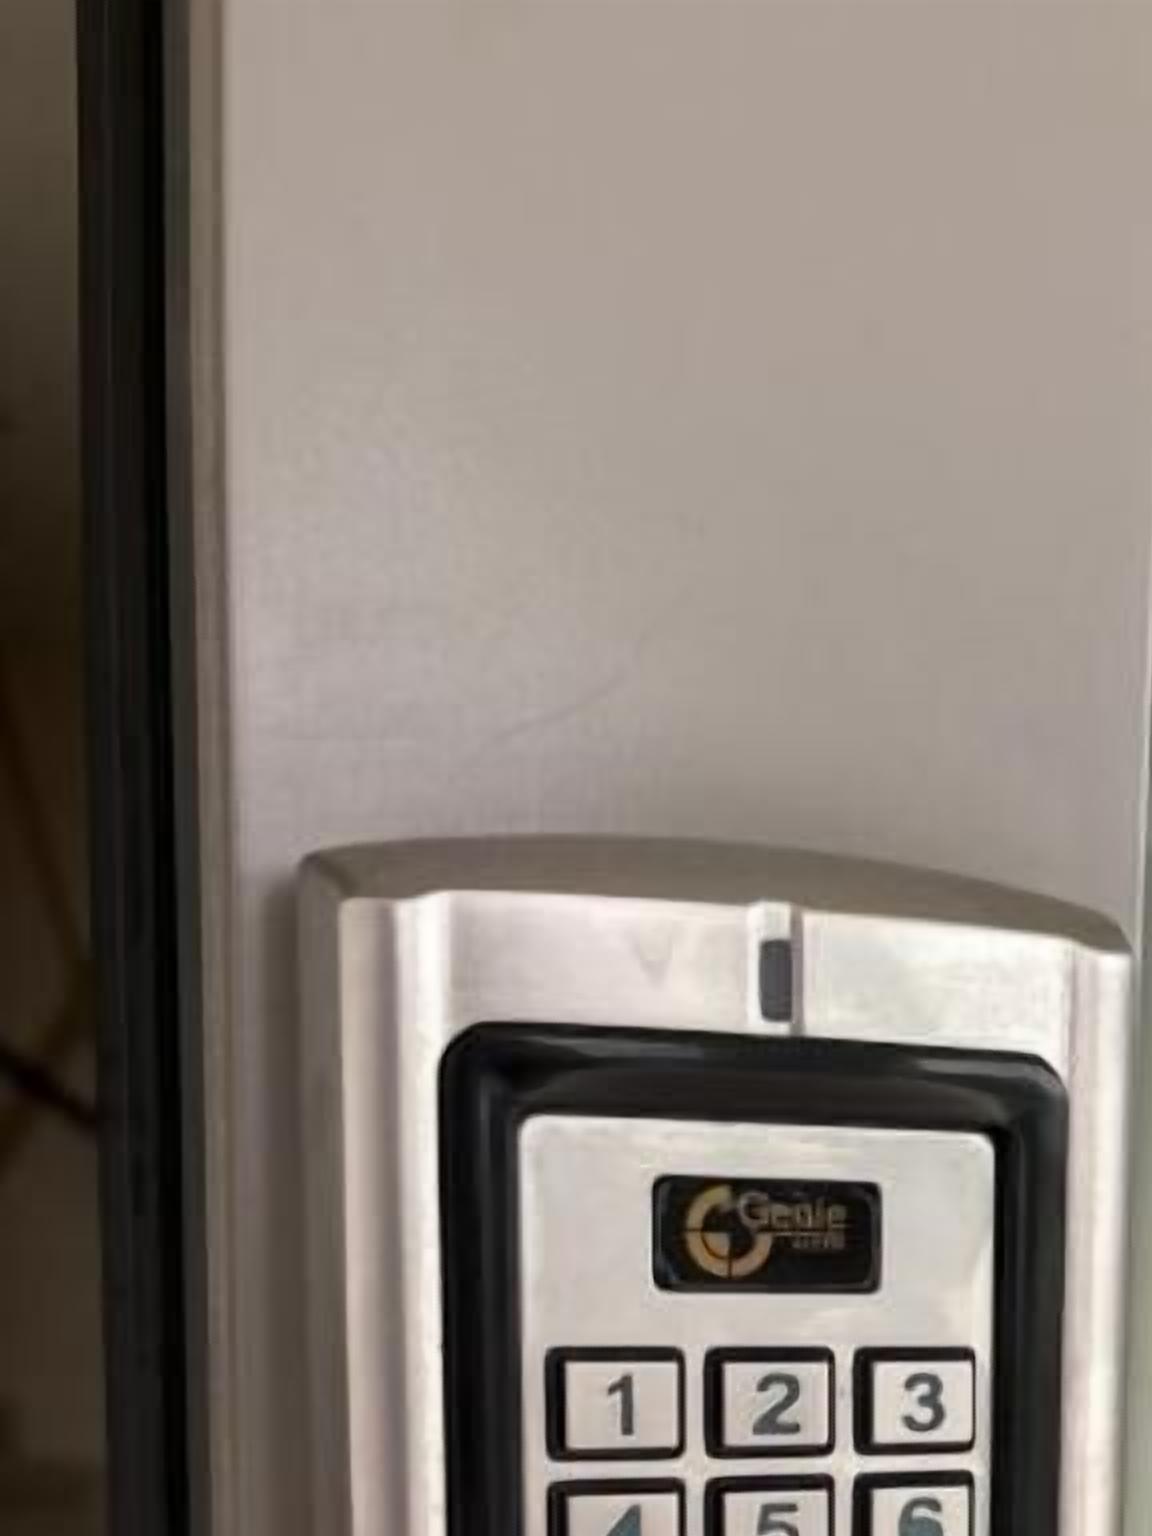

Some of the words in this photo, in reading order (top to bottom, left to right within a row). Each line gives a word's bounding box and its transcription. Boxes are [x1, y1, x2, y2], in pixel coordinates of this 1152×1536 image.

[607, 1374, 634, 1436] 1
[753, 1373, 801, 1435] 2
[902, 1373, 946, 1432] 3
